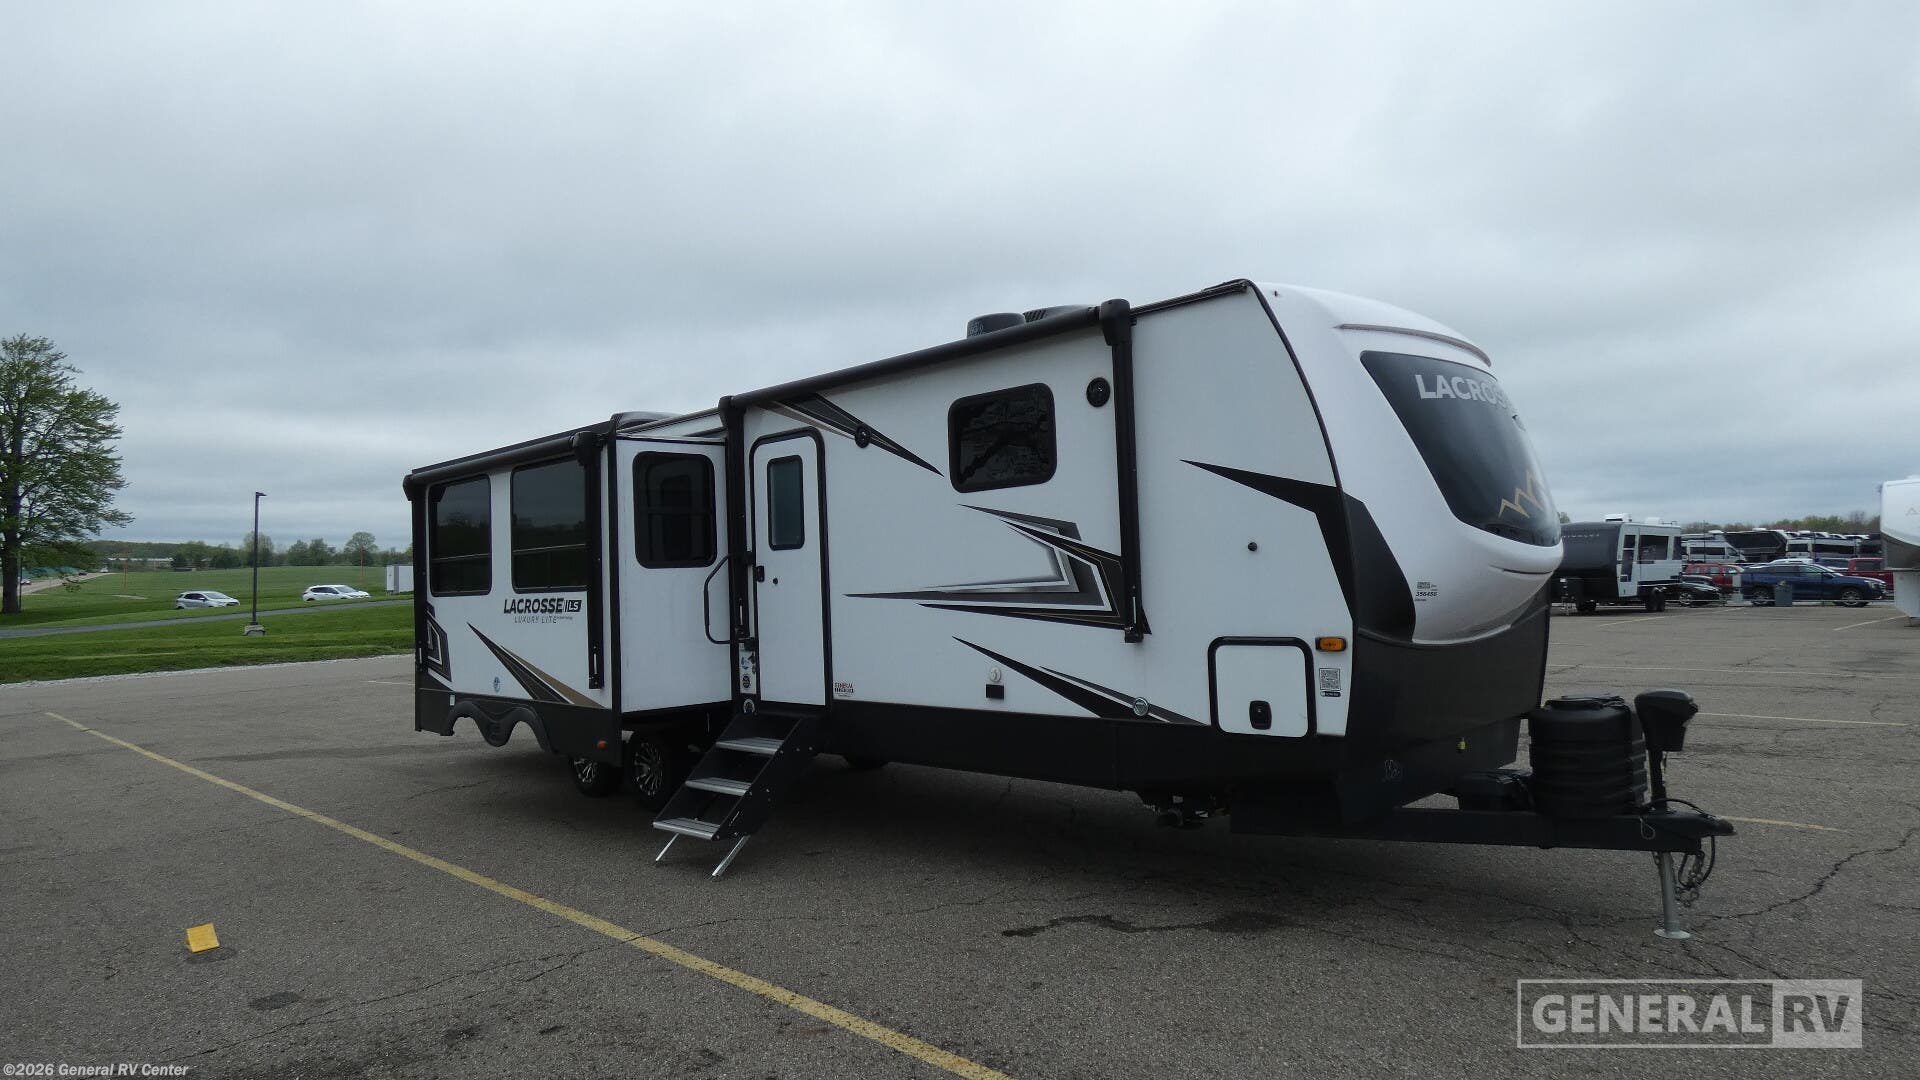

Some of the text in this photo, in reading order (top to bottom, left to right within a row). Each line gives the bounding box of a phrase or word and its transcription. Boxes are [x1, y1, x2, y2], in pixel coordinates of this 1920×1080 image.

[1415, 374, 1514, 411] LACROS
[504, 598, 564, 613] LACROSSE
[514, 616, 539, 624] LUXURY
[541, 616, 557, 624] LITE
